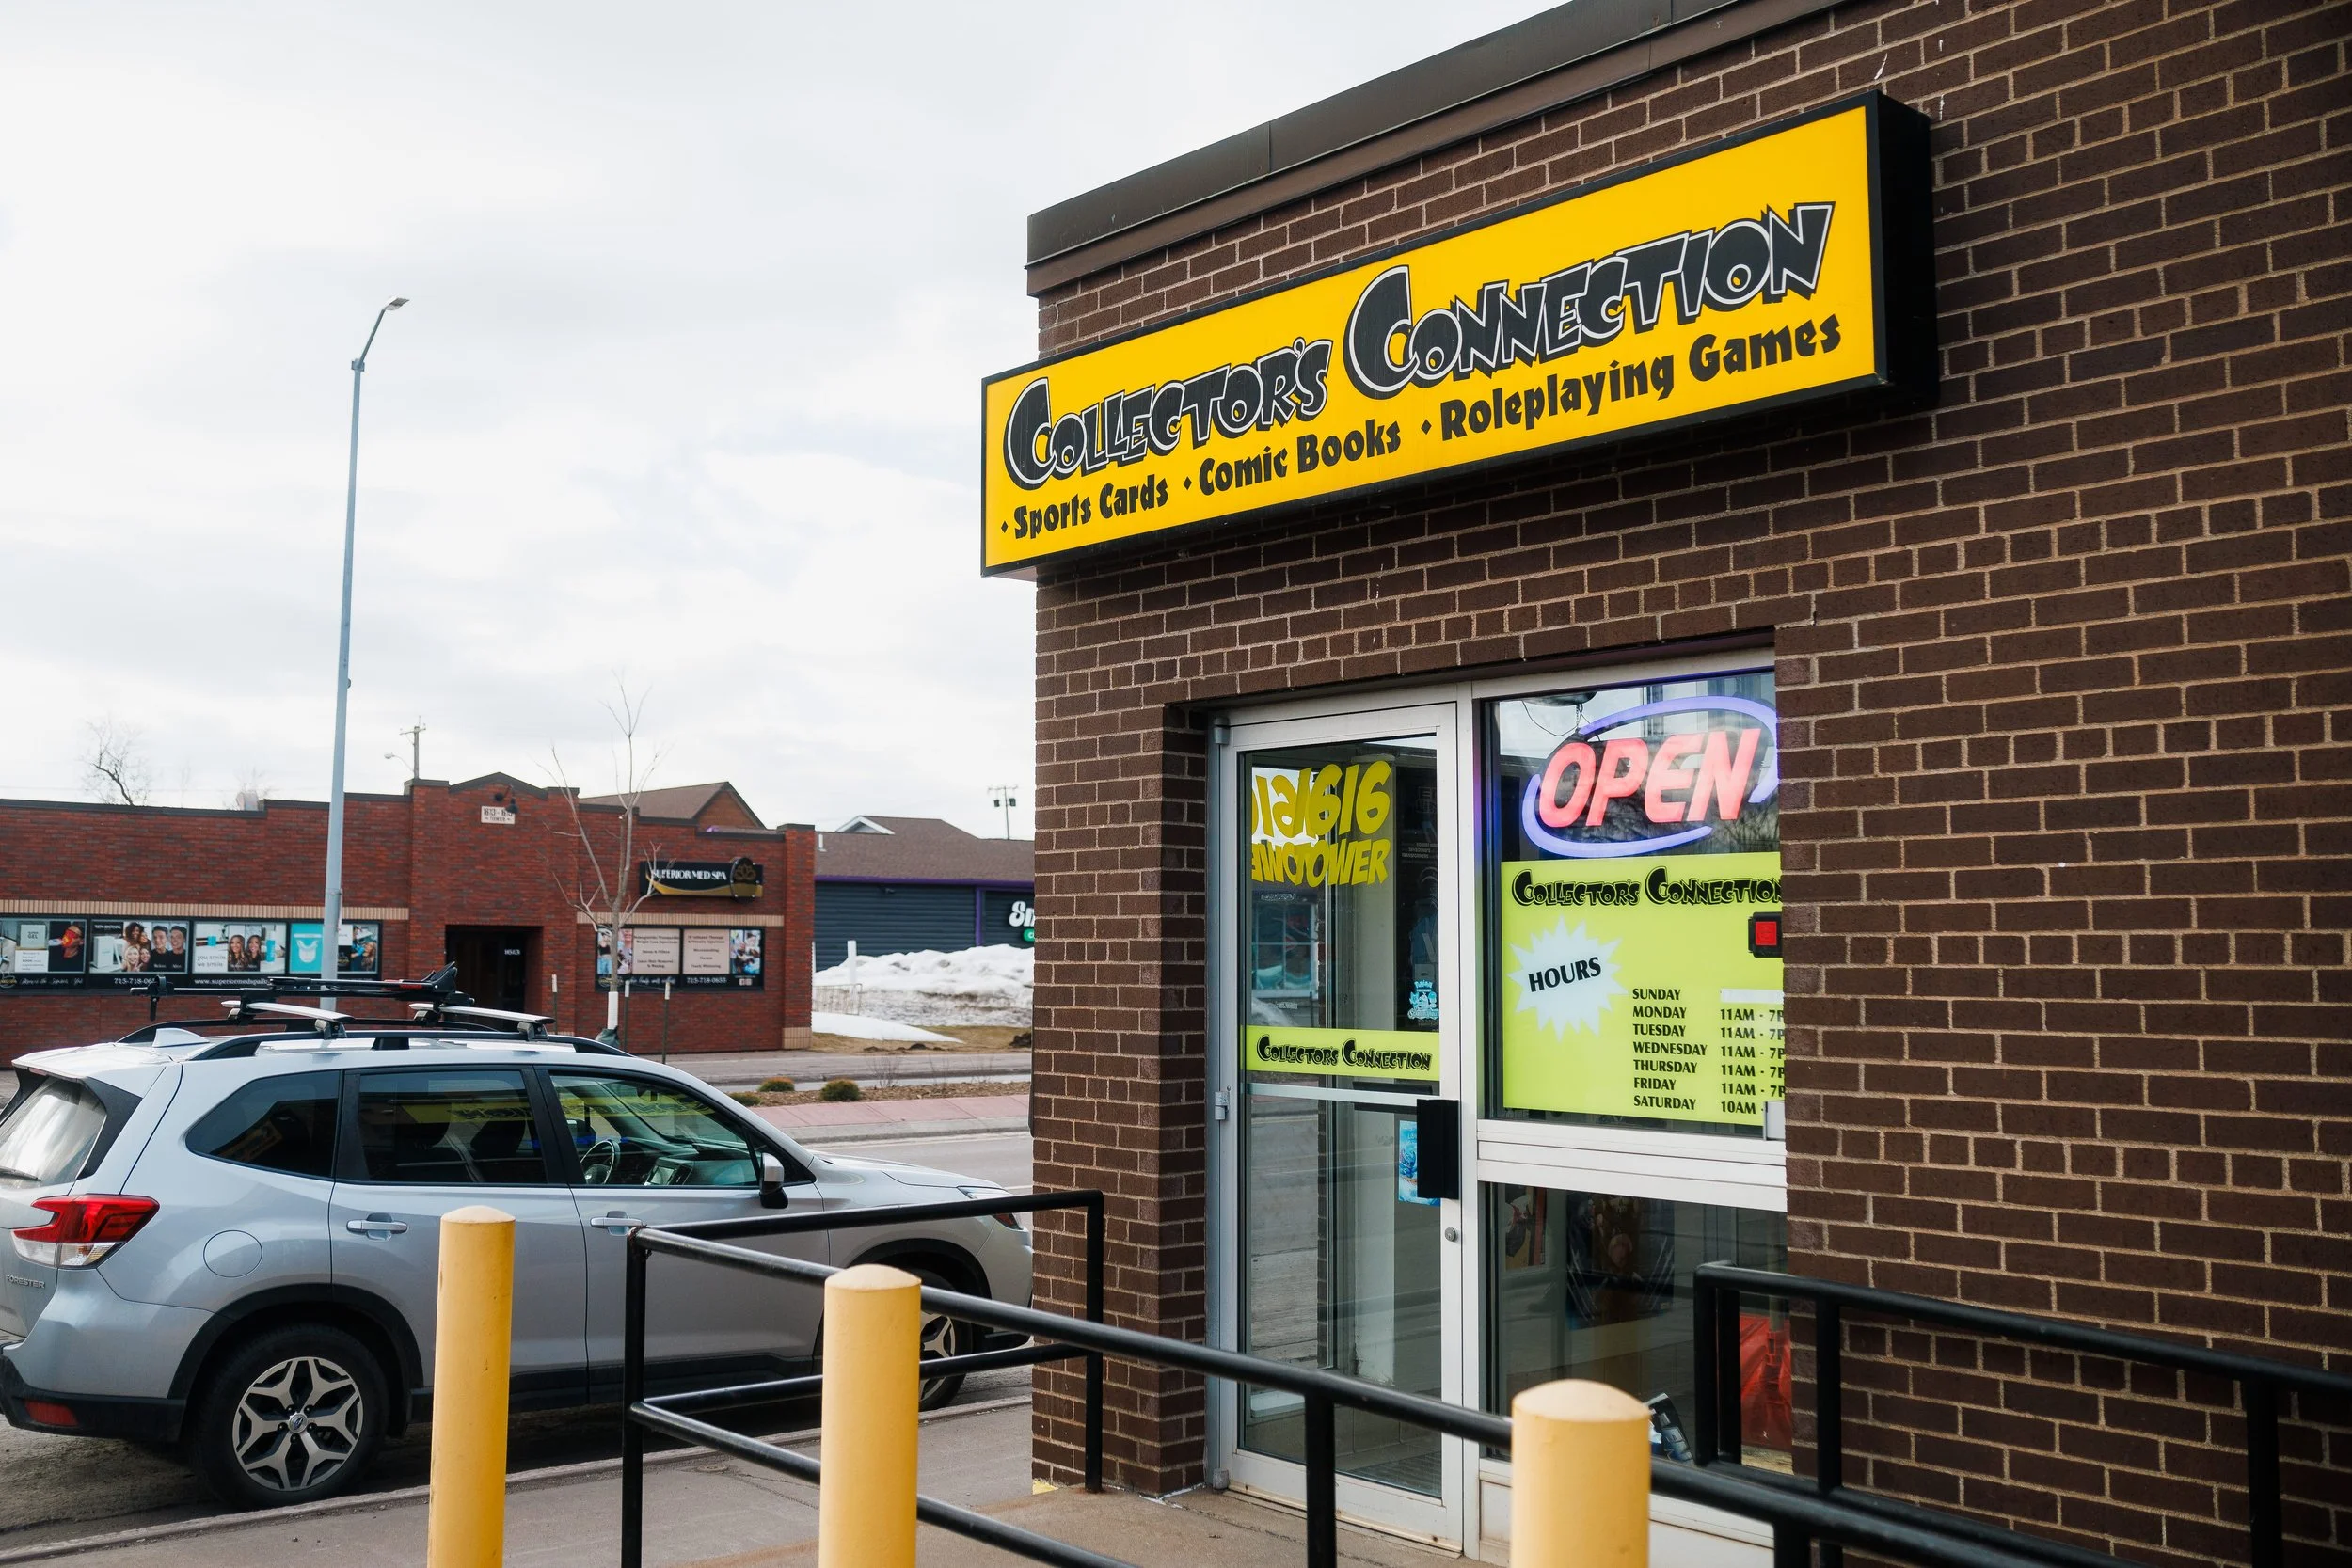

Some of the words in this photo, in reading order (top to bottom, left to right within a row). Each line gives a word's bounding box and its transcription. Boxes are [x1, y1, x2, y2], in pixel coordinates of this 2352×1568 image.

[1003, 337, 1334, 491] COLLECTOR'S
[1343, 201, 1836, 401] CONNECTION
[1013, 493, 1092, 539] Sports
[1099, 474, 1169, 519] Cards
[1199, 446, 1288, 496] Comic
[1297, 419, 1402, 473] Books
[1439, 352, 1676, 442] Roleplaying
[1688, 314, 1842, 382] Games
[1537, 727, 1762, 829] OPEN
[691, 870, 710, 880] MED
[710, 871, 727, 880] SPA
[1528, 957, 1602, 992] HOURS
[1632, 988, 1681, 1000] SUNDAY
[1632, 1006, 1687, 1019] MONDAY
[1720, 1008, 1755, 1021] 11AM
[1769, 1009, 1784, 1022] 7P
[1632, 1023, 1686, 1037] TUESDAY
[1720, 1027, 1756, 1039] 11AM
[1769, 1028, 1785, 1040] 7P
[1341, 1038, 1433, 1071] CONNECTION
[1632, 1041, 1708, 1055] WEDNESDAY
[1721, 1045, 1756, 1058] 11AM
[1769, 1047, 1785, 1059] 7P
[1633, 1059, 1697, 1073] THURSDAY
[1721, 1064, 1756, 1077] 11AM
[1770, 1066, 1785, 1078] 7P
[1633, 1077, 1676, 1090] FRIDAY
[1721, 1083, 1756, 1095] 11AM
[1770, 1085, 1786, 1097] 7P
[1633, 1095, 1696, 1110] SATURDAY
[1721, 1101, 1756, 1114] 10AM
[6, 1274, 45, 1289] FORESTER
